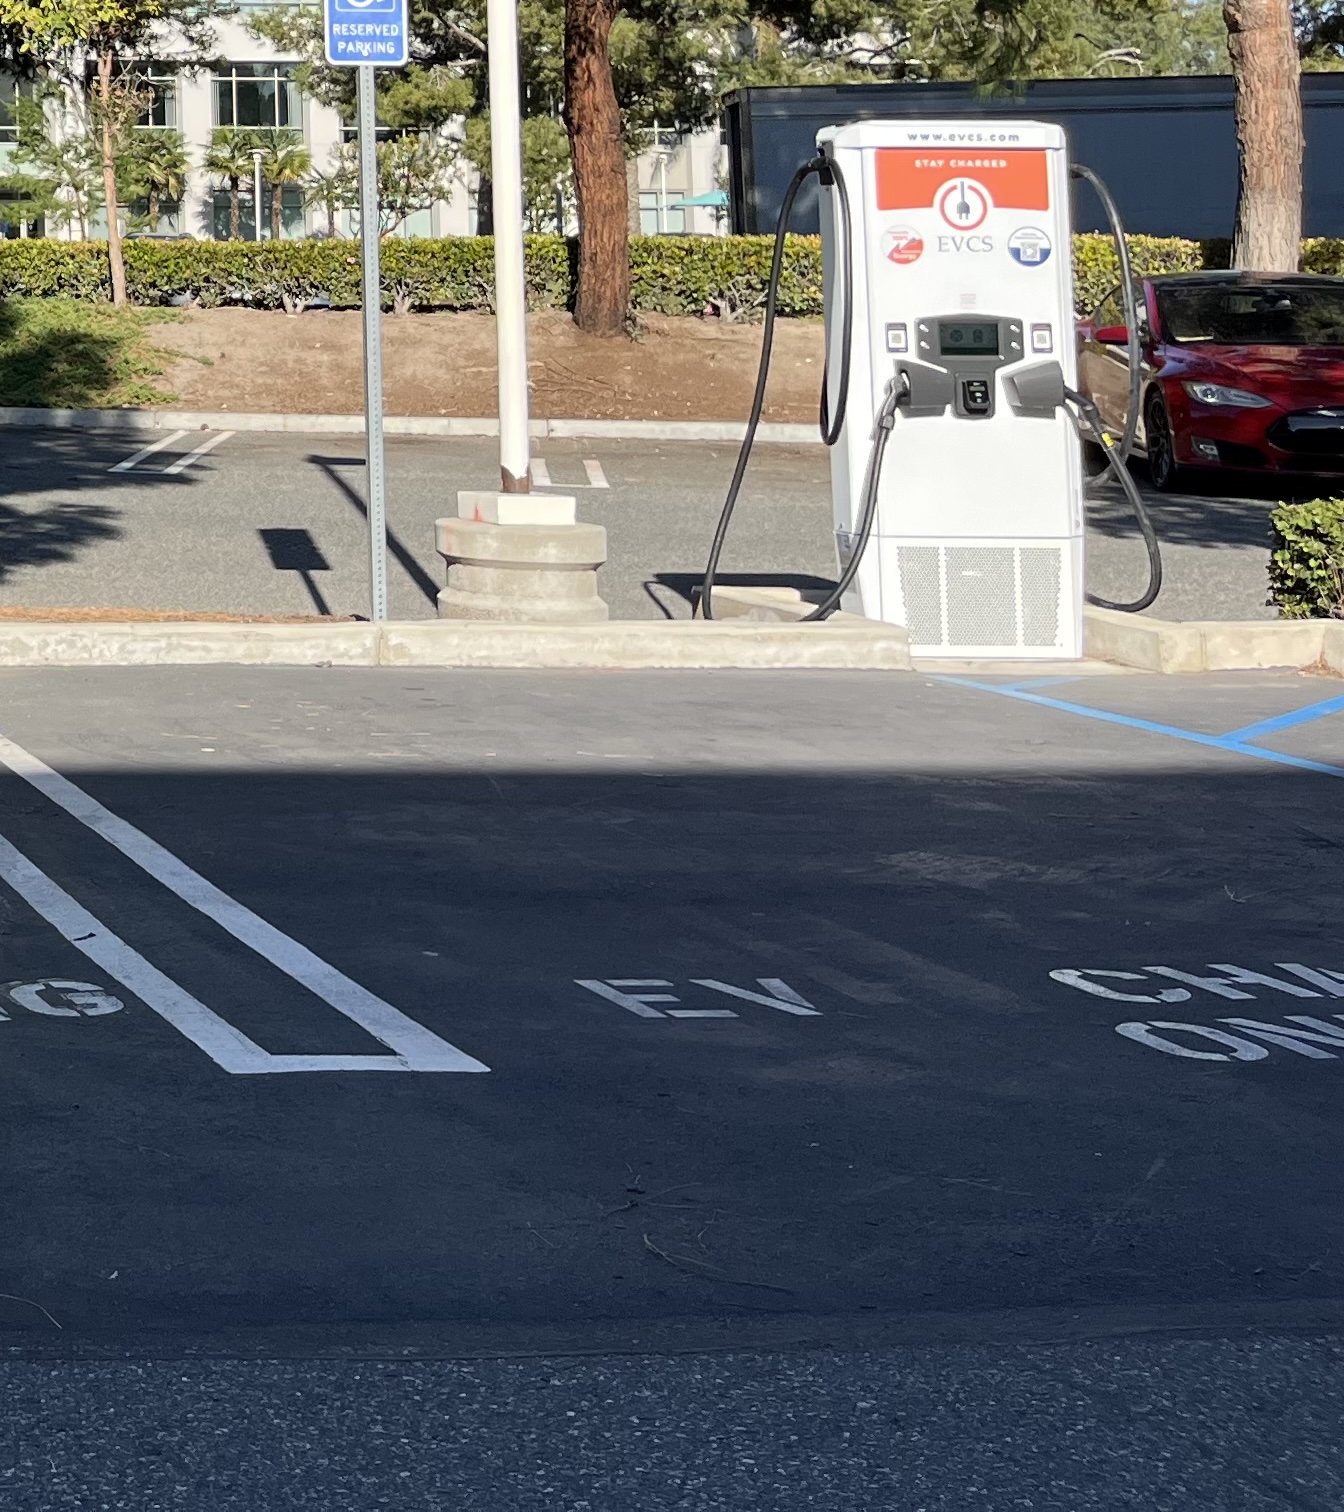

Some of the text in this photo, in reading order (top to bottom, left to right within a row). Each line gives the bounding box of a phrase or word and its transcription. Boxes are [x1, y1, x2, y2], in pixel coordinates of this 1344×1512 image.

[332, 23, 399, 36] RESERVED
[337, 41, 395, 54] PARKING
[907, 133, 1020, 142] www.evcs.com
[914, 159, 1008, 168] STAY CHARGED
[937, 235, 994, 252] EVCS
[573, 978, 824, 1018] EV
[1115, 1014, 1344, 1061] ON
